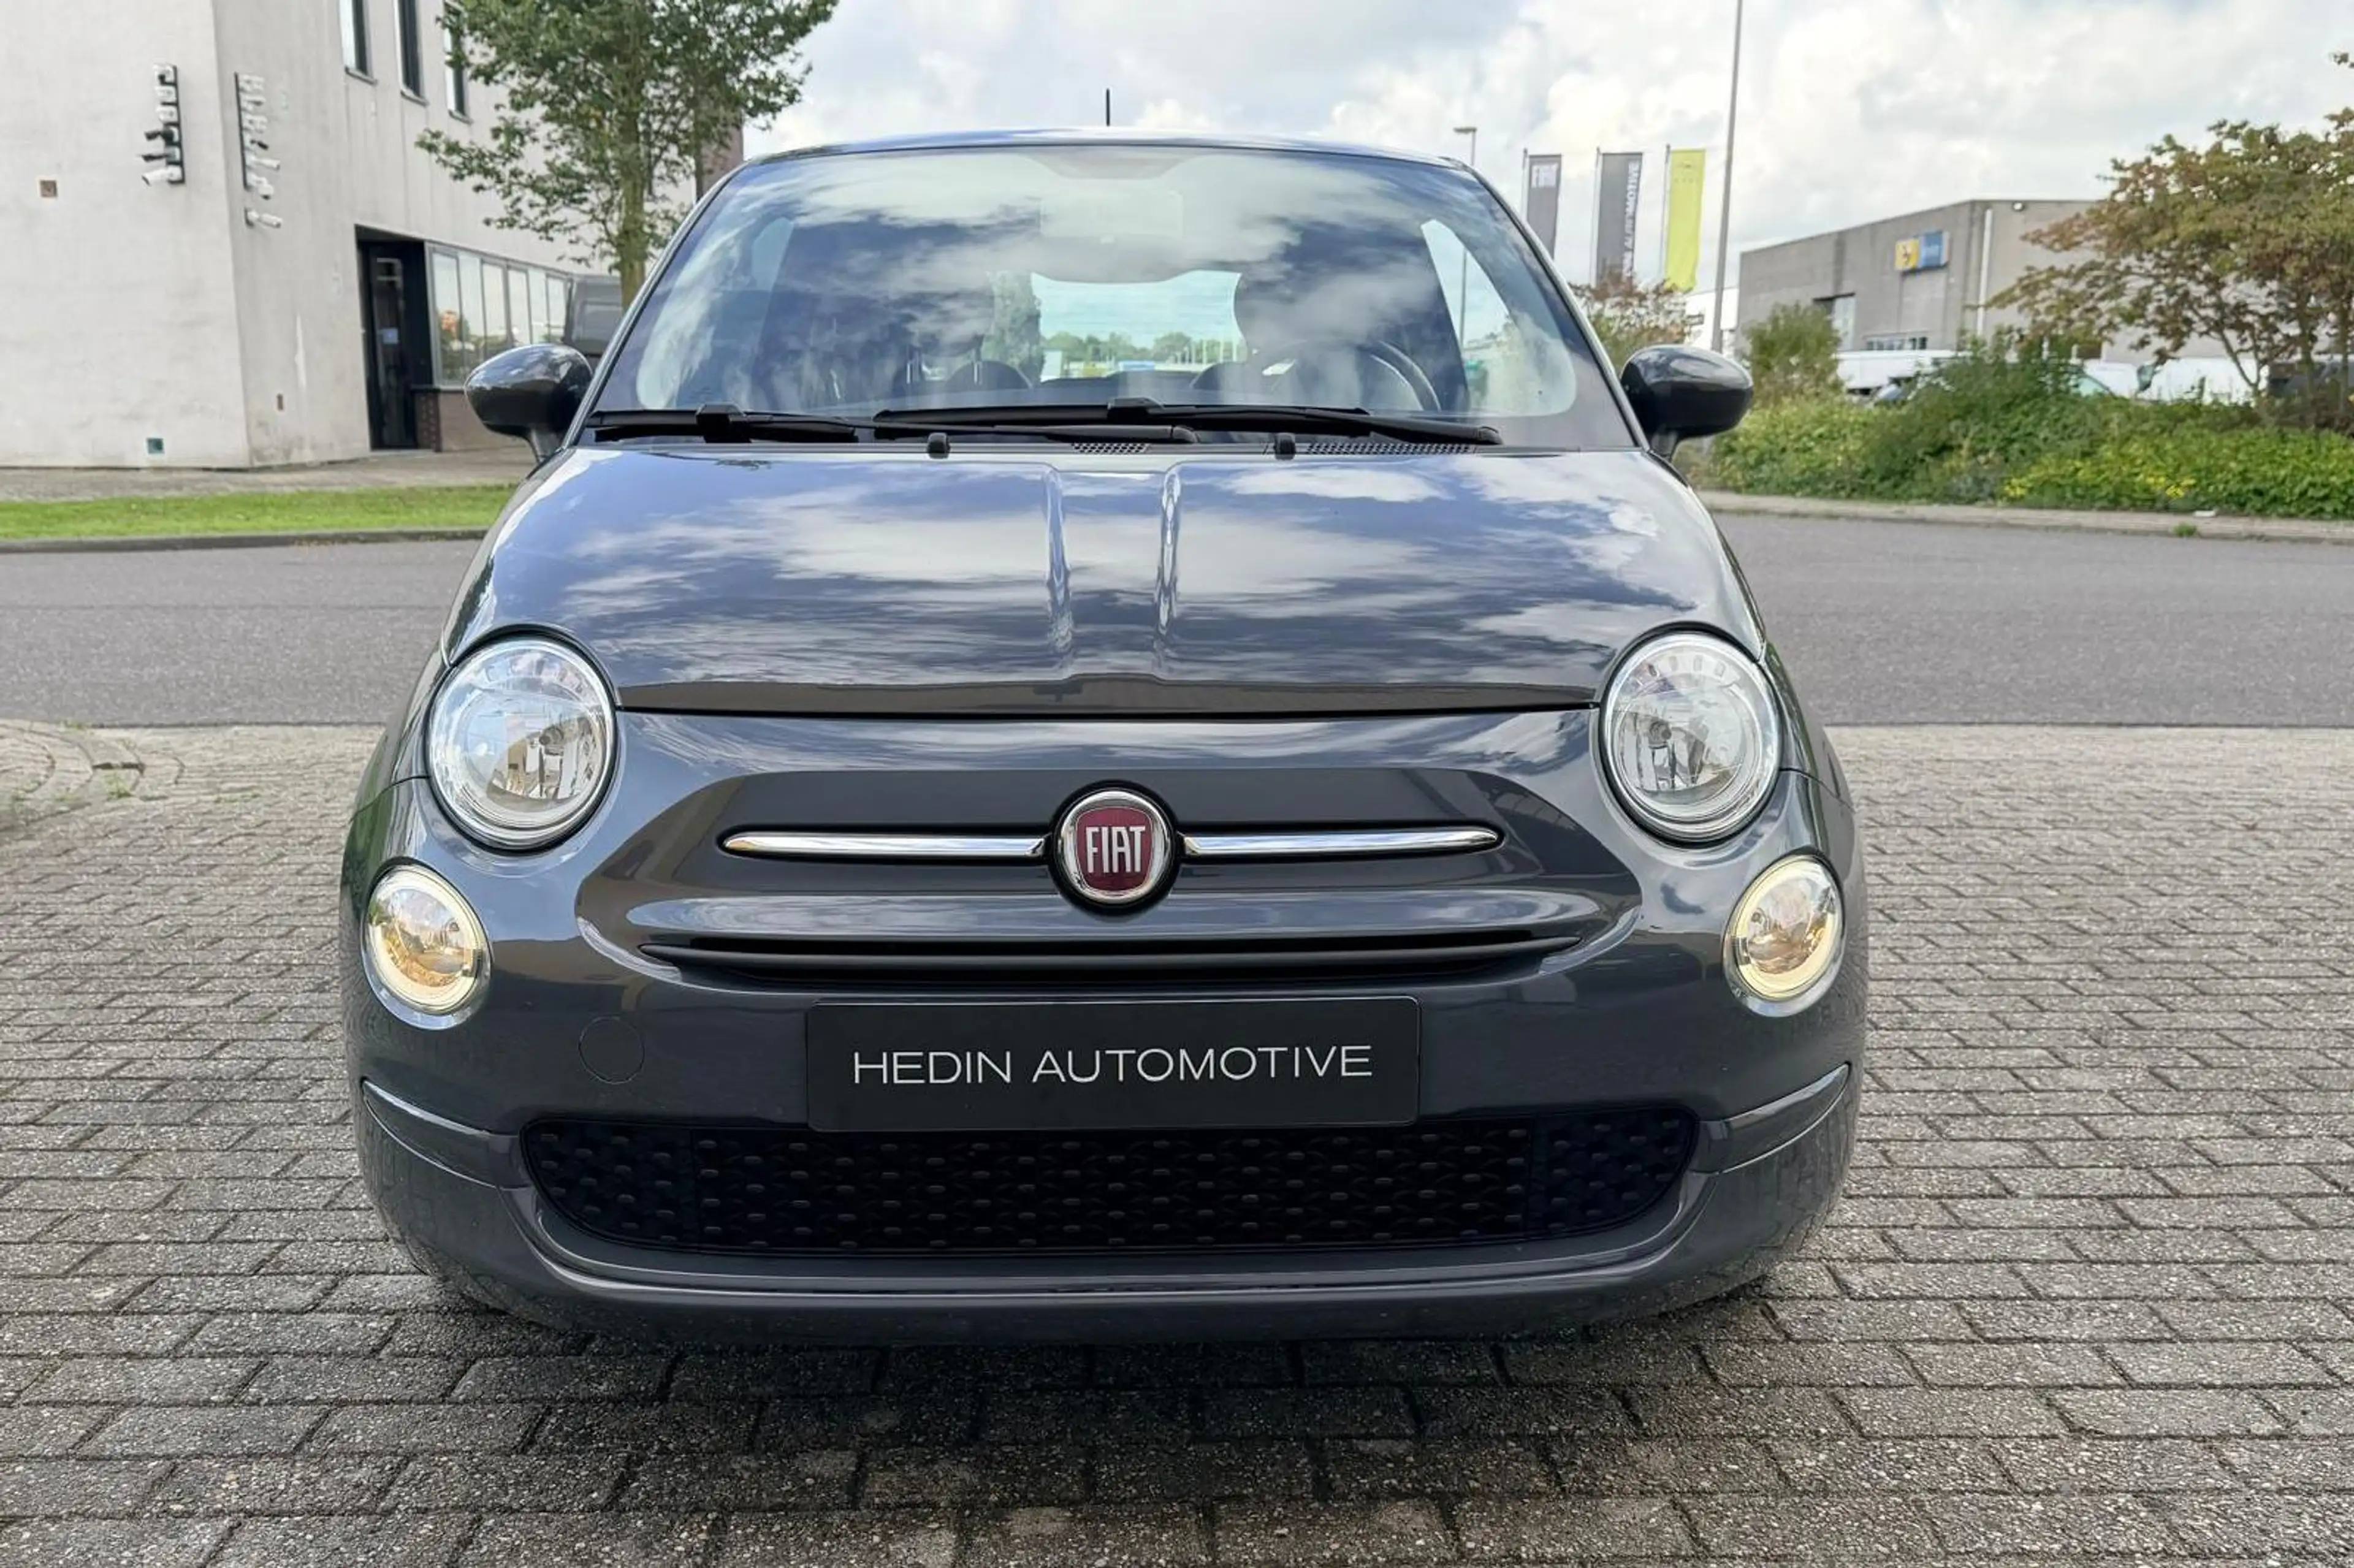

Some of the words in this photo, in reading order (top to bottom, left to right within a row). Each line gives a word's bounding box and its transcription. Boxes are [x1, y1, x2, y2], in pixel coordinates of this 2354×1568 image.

[1085, 826, 1146, 873] FIAT
[854, 1050, 1011, 1084] HEDIN
[1032, 1045, 1373, 1083] AUTOMOTIVE
